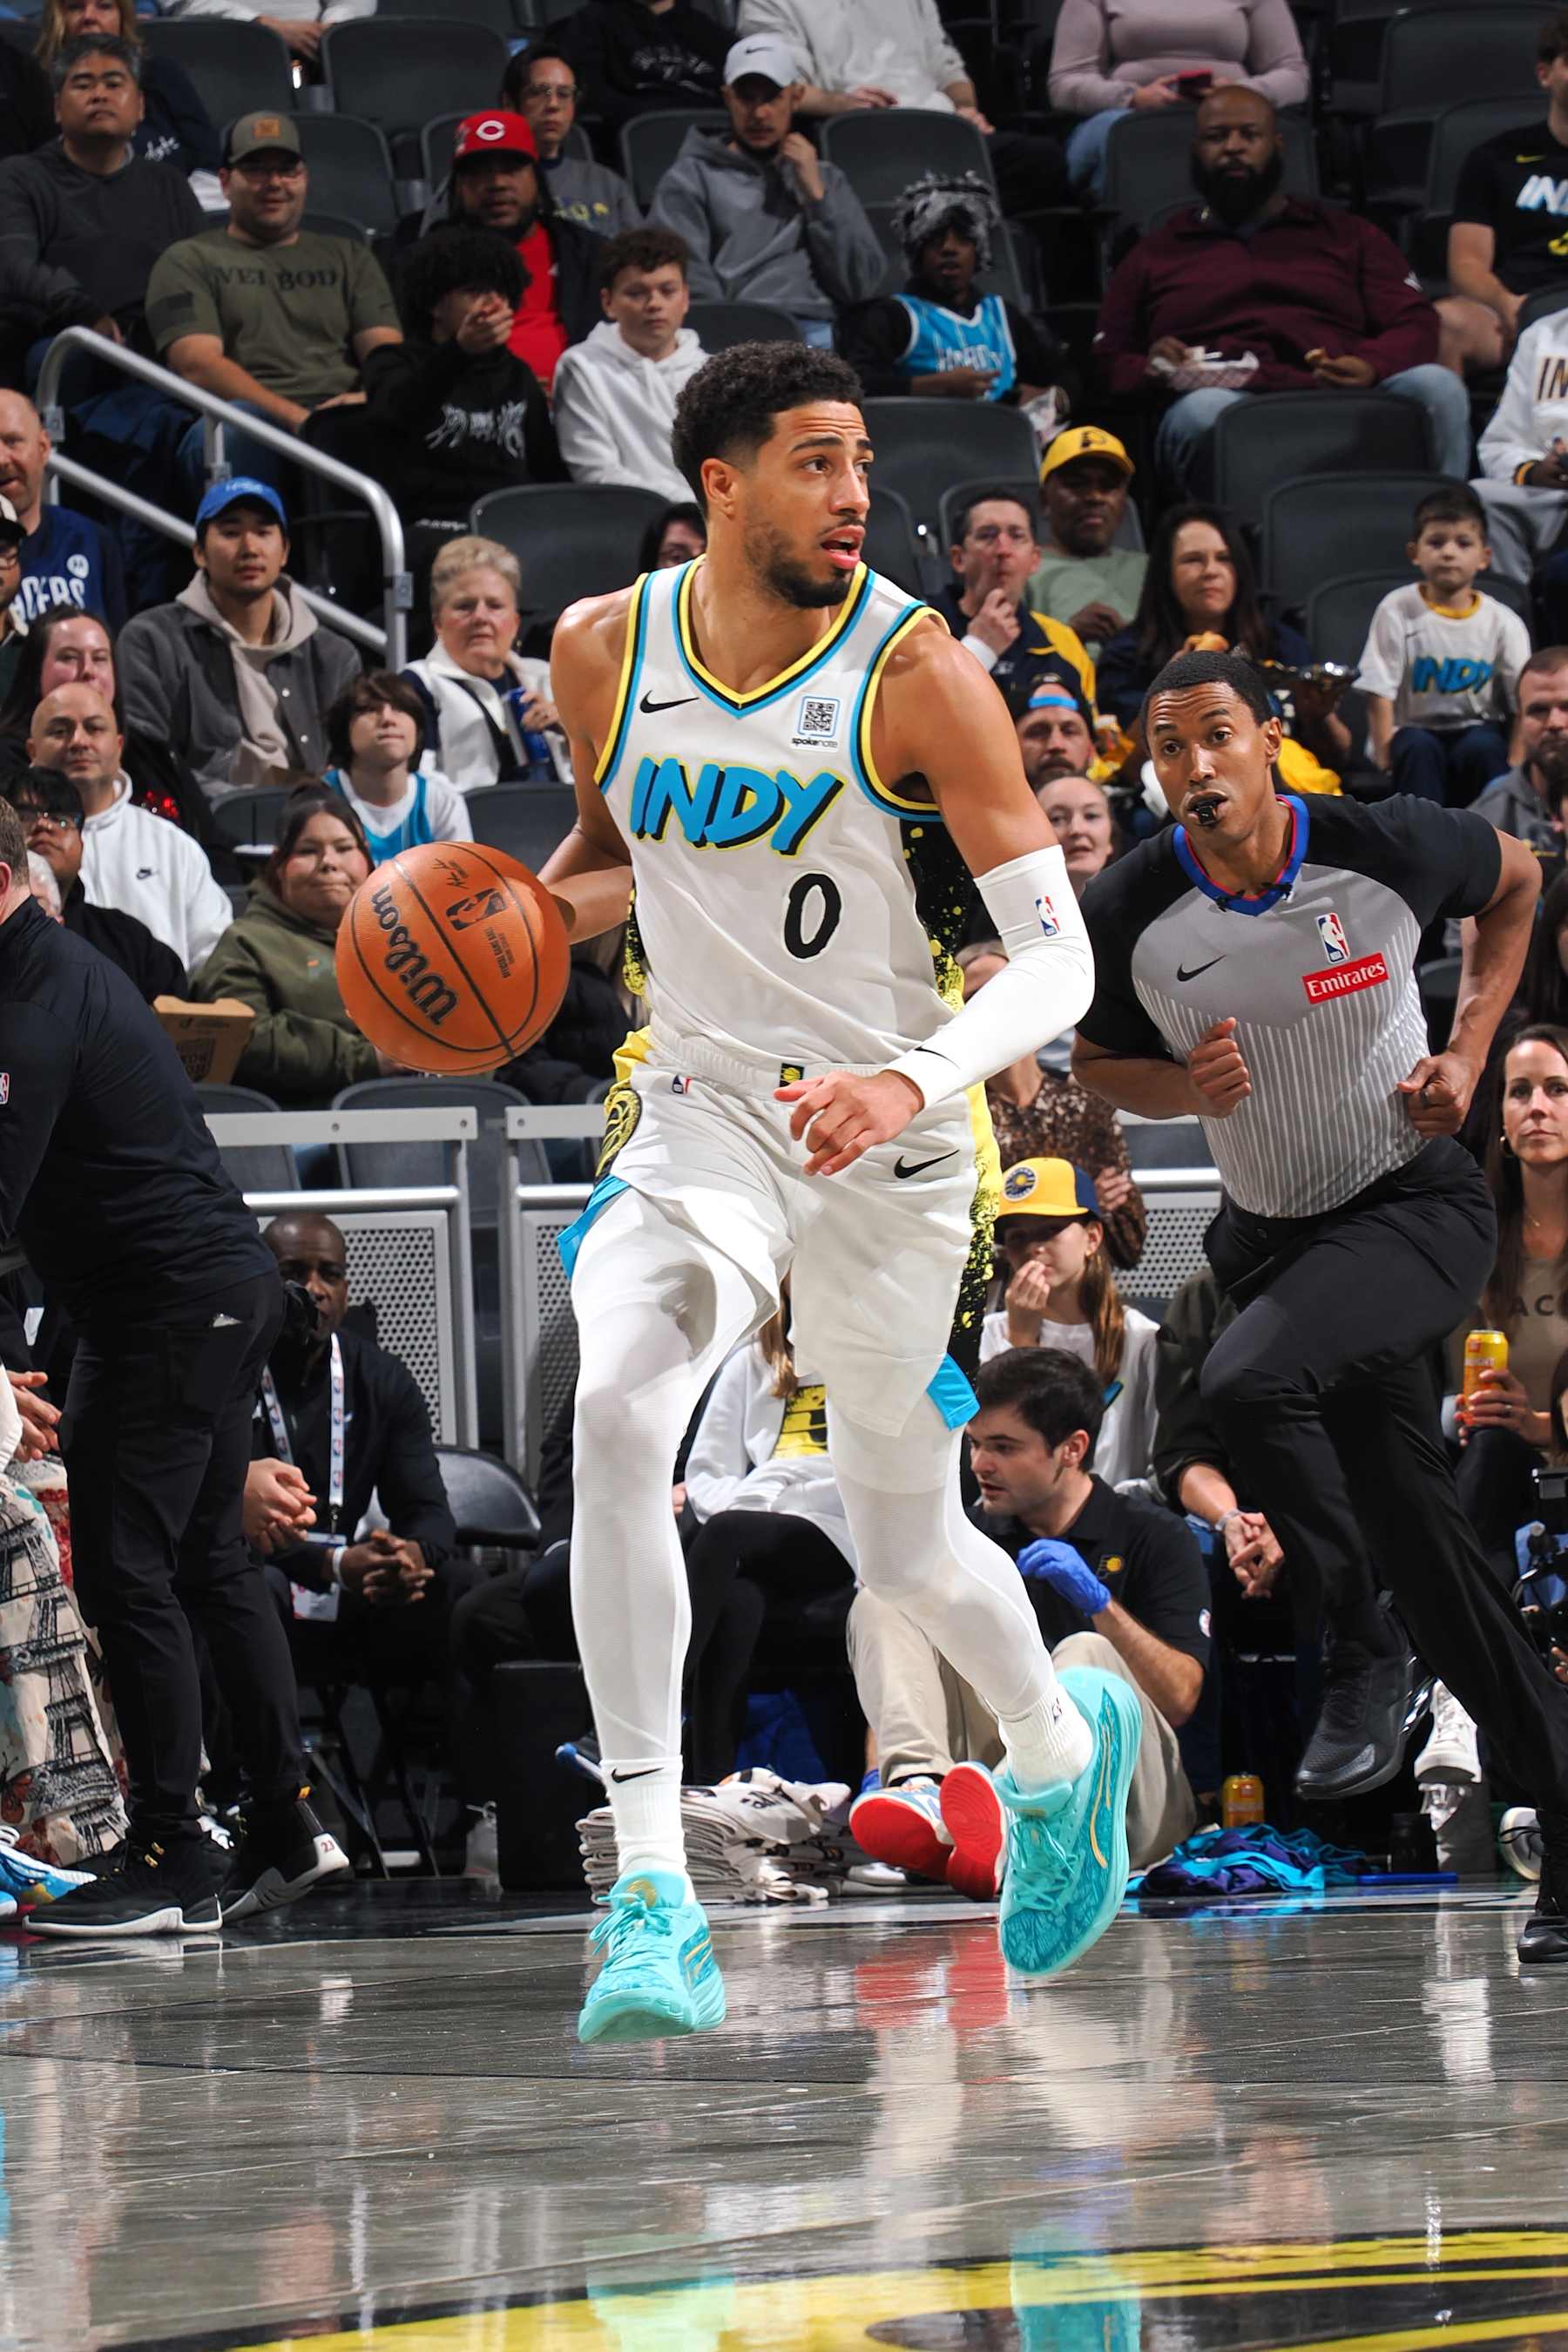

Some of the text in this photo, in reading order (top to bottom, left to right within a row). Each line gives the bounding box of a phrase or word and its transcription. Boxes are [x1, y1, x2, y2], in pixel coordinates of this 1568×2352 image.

[630, 756, 844, 856] INDY
[370, 882, 461, 1026] Wilson
[783, 871, 843, 960] 0
[1307, 962, 1386, 997] Emirates
